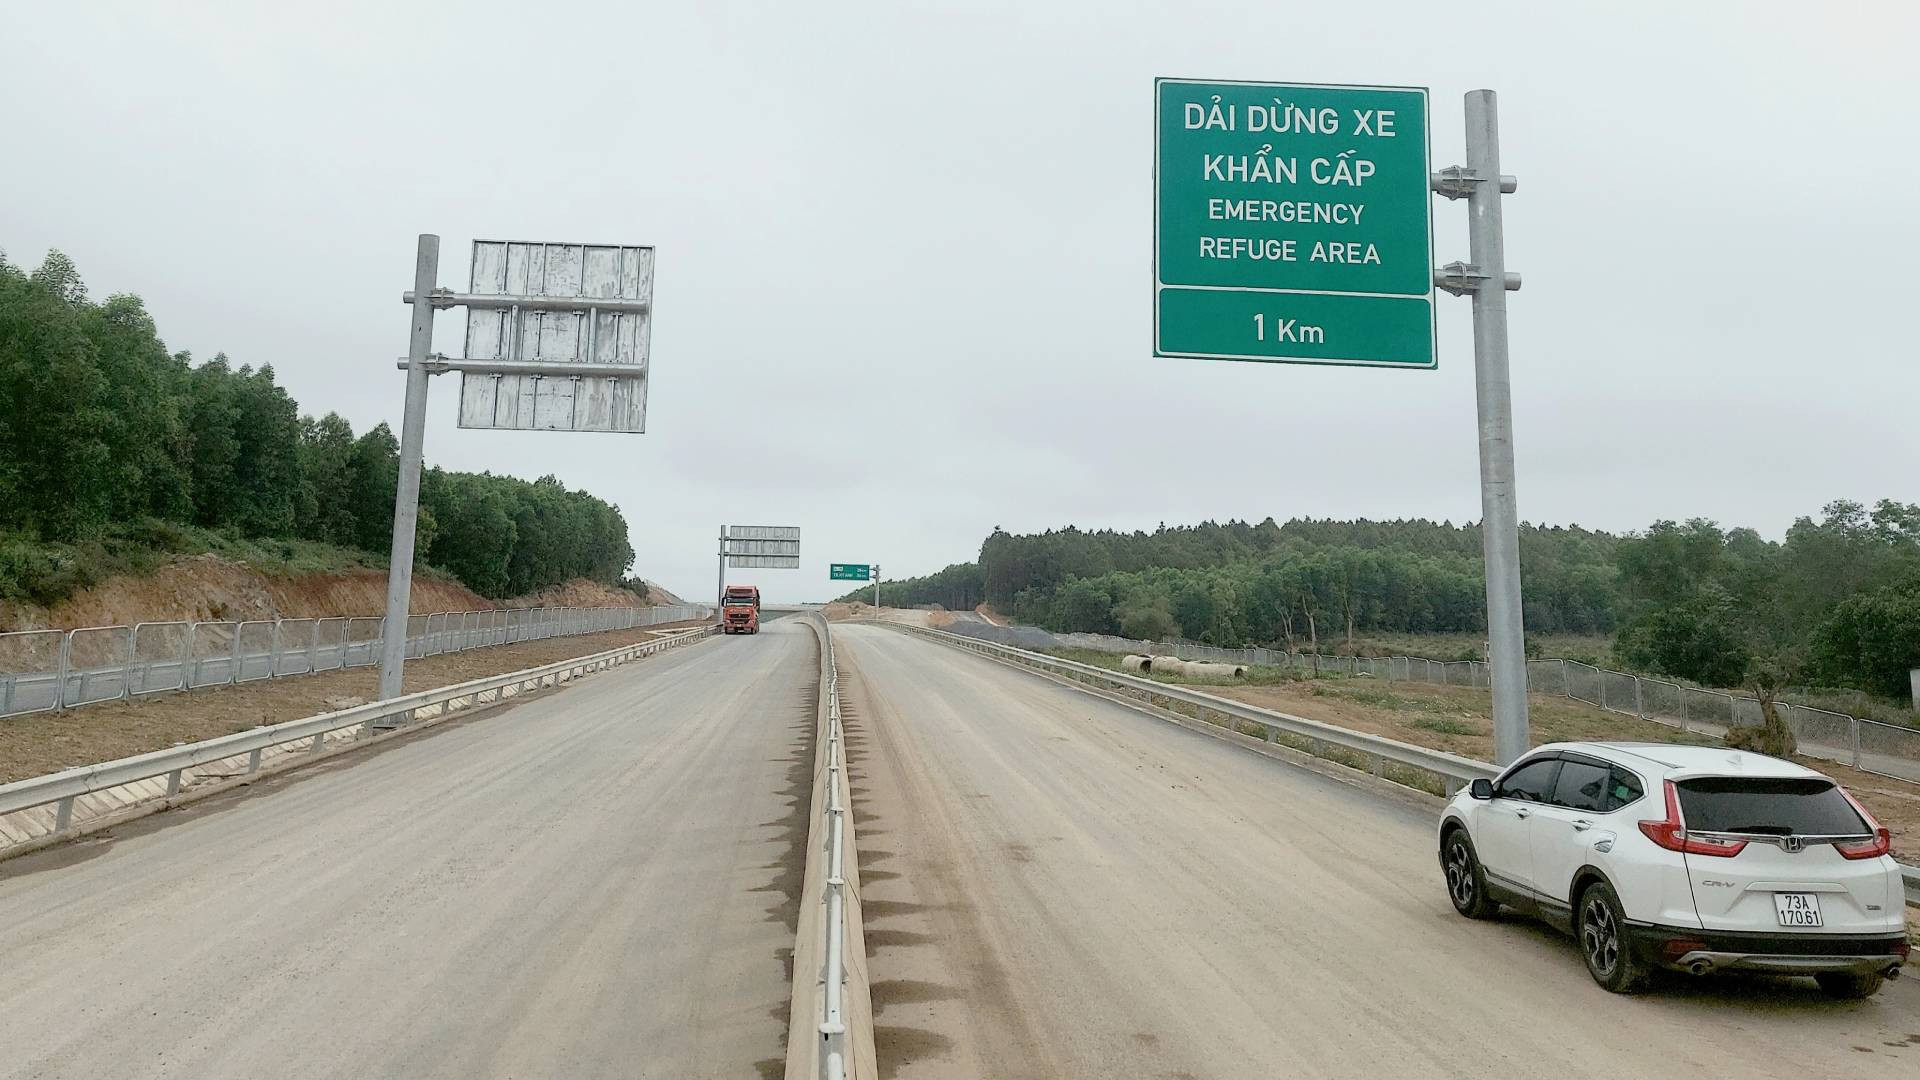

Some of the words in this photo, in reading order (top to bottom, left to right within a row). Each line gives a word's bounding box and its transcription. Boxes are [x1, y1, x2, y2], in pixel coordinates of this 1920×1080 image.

[1184, 94, 1236, 131] DẢI
[1247, 97, 1339, 135] DỪNG
[1352, 109, 1396, 137] XE
[1203, 143, 1297, 184] KHẨN
[1310, 149, 1376, 187] CẤP
[1208, 198, 1365, 225] EMERGENCY
[1199, 236, 1297, 262] REFUGE
[1309, 241, 1382, 265] AREA
[1253, 313, 1265, 341] 1
[1278, 319, 1324, 344] Km
[1785, 895, 1810, 910] 73A
[1780, 910, 1819, 925] 170.61
